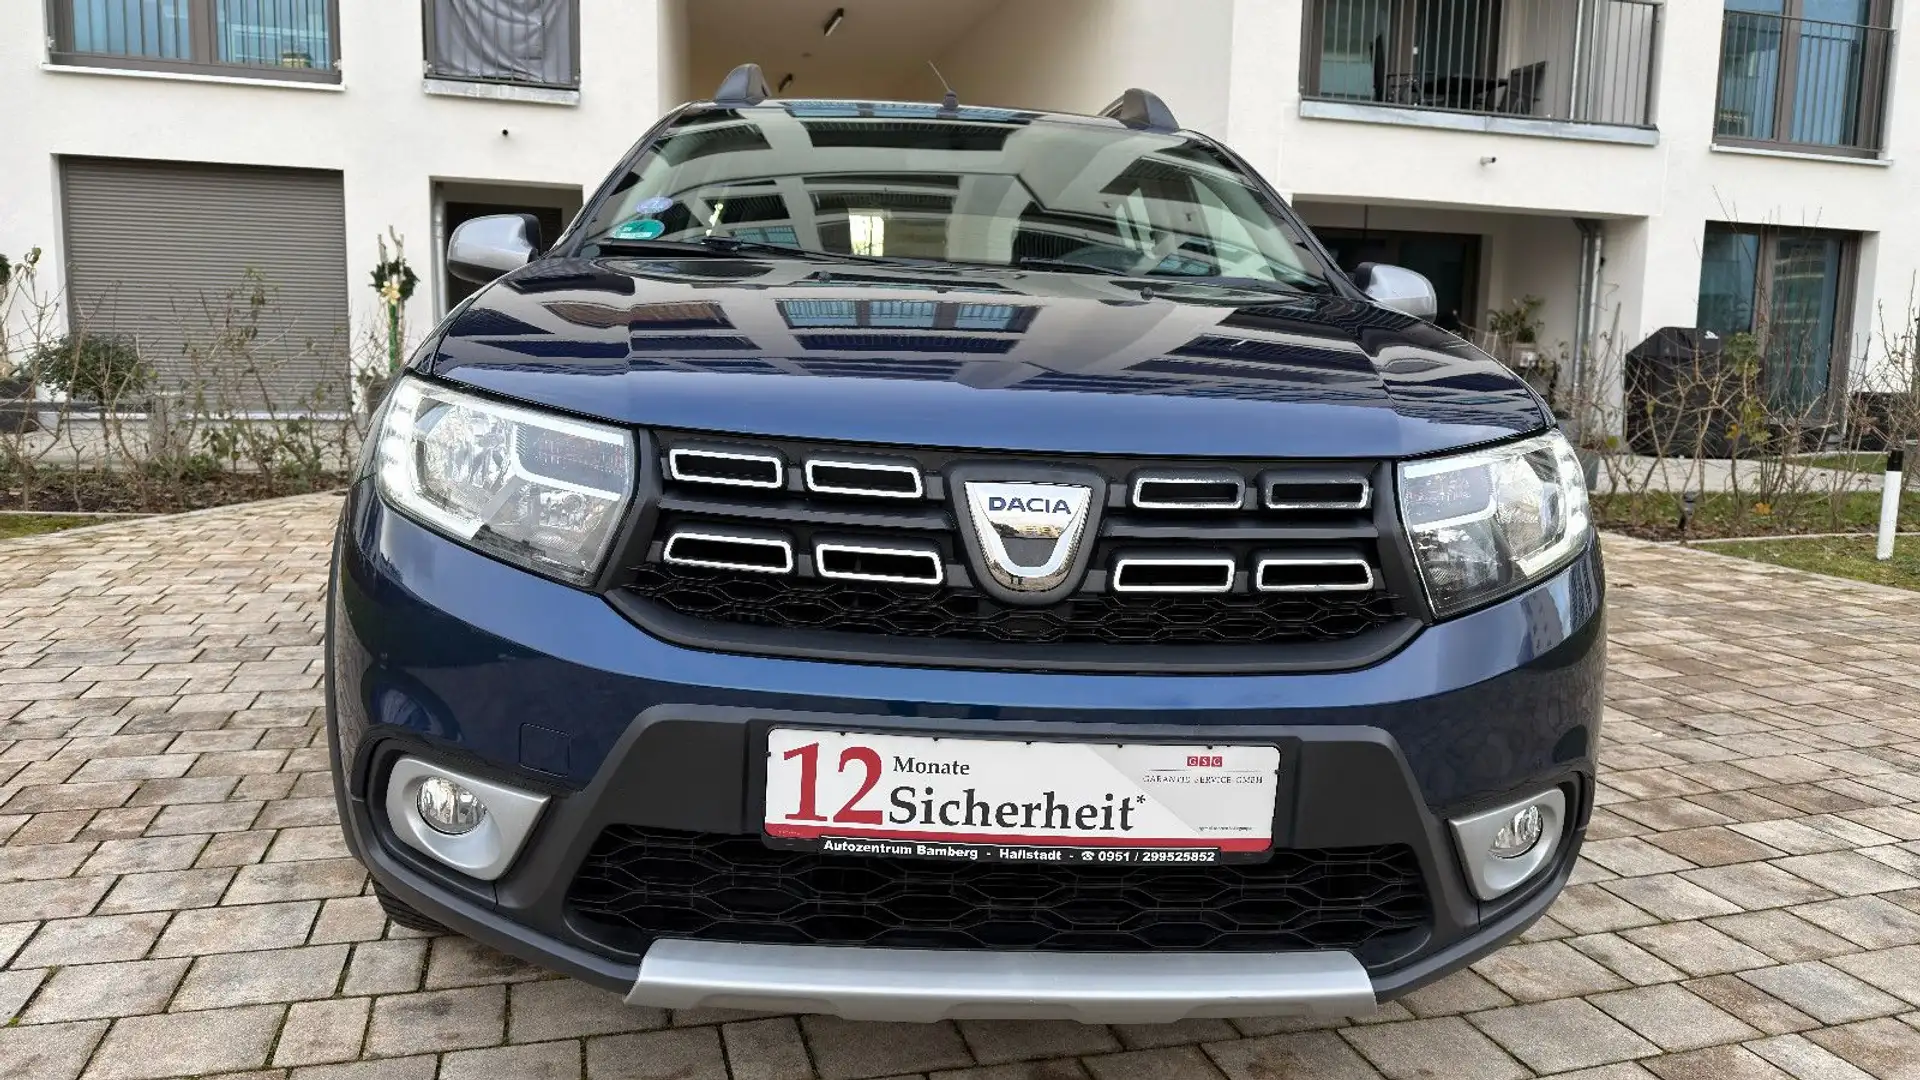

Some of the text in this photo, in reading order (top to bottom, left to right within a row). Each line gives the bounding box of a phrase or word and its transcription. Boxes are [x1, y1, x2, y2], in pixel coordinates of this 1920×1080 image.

[989, 497, 1071, 514] DACIA
[893, 756, 970, 775] Monate
[784, 742, 883, 825] 12
[823, 840, 912, 855] Autozentrum
[916, 845, 978, 860] Bamberg
[999, 848, 1062, 861] Hallstadt
[1098, 851, 1130, 862] 0951
[1142, 851, 1216, 862] 299525852
